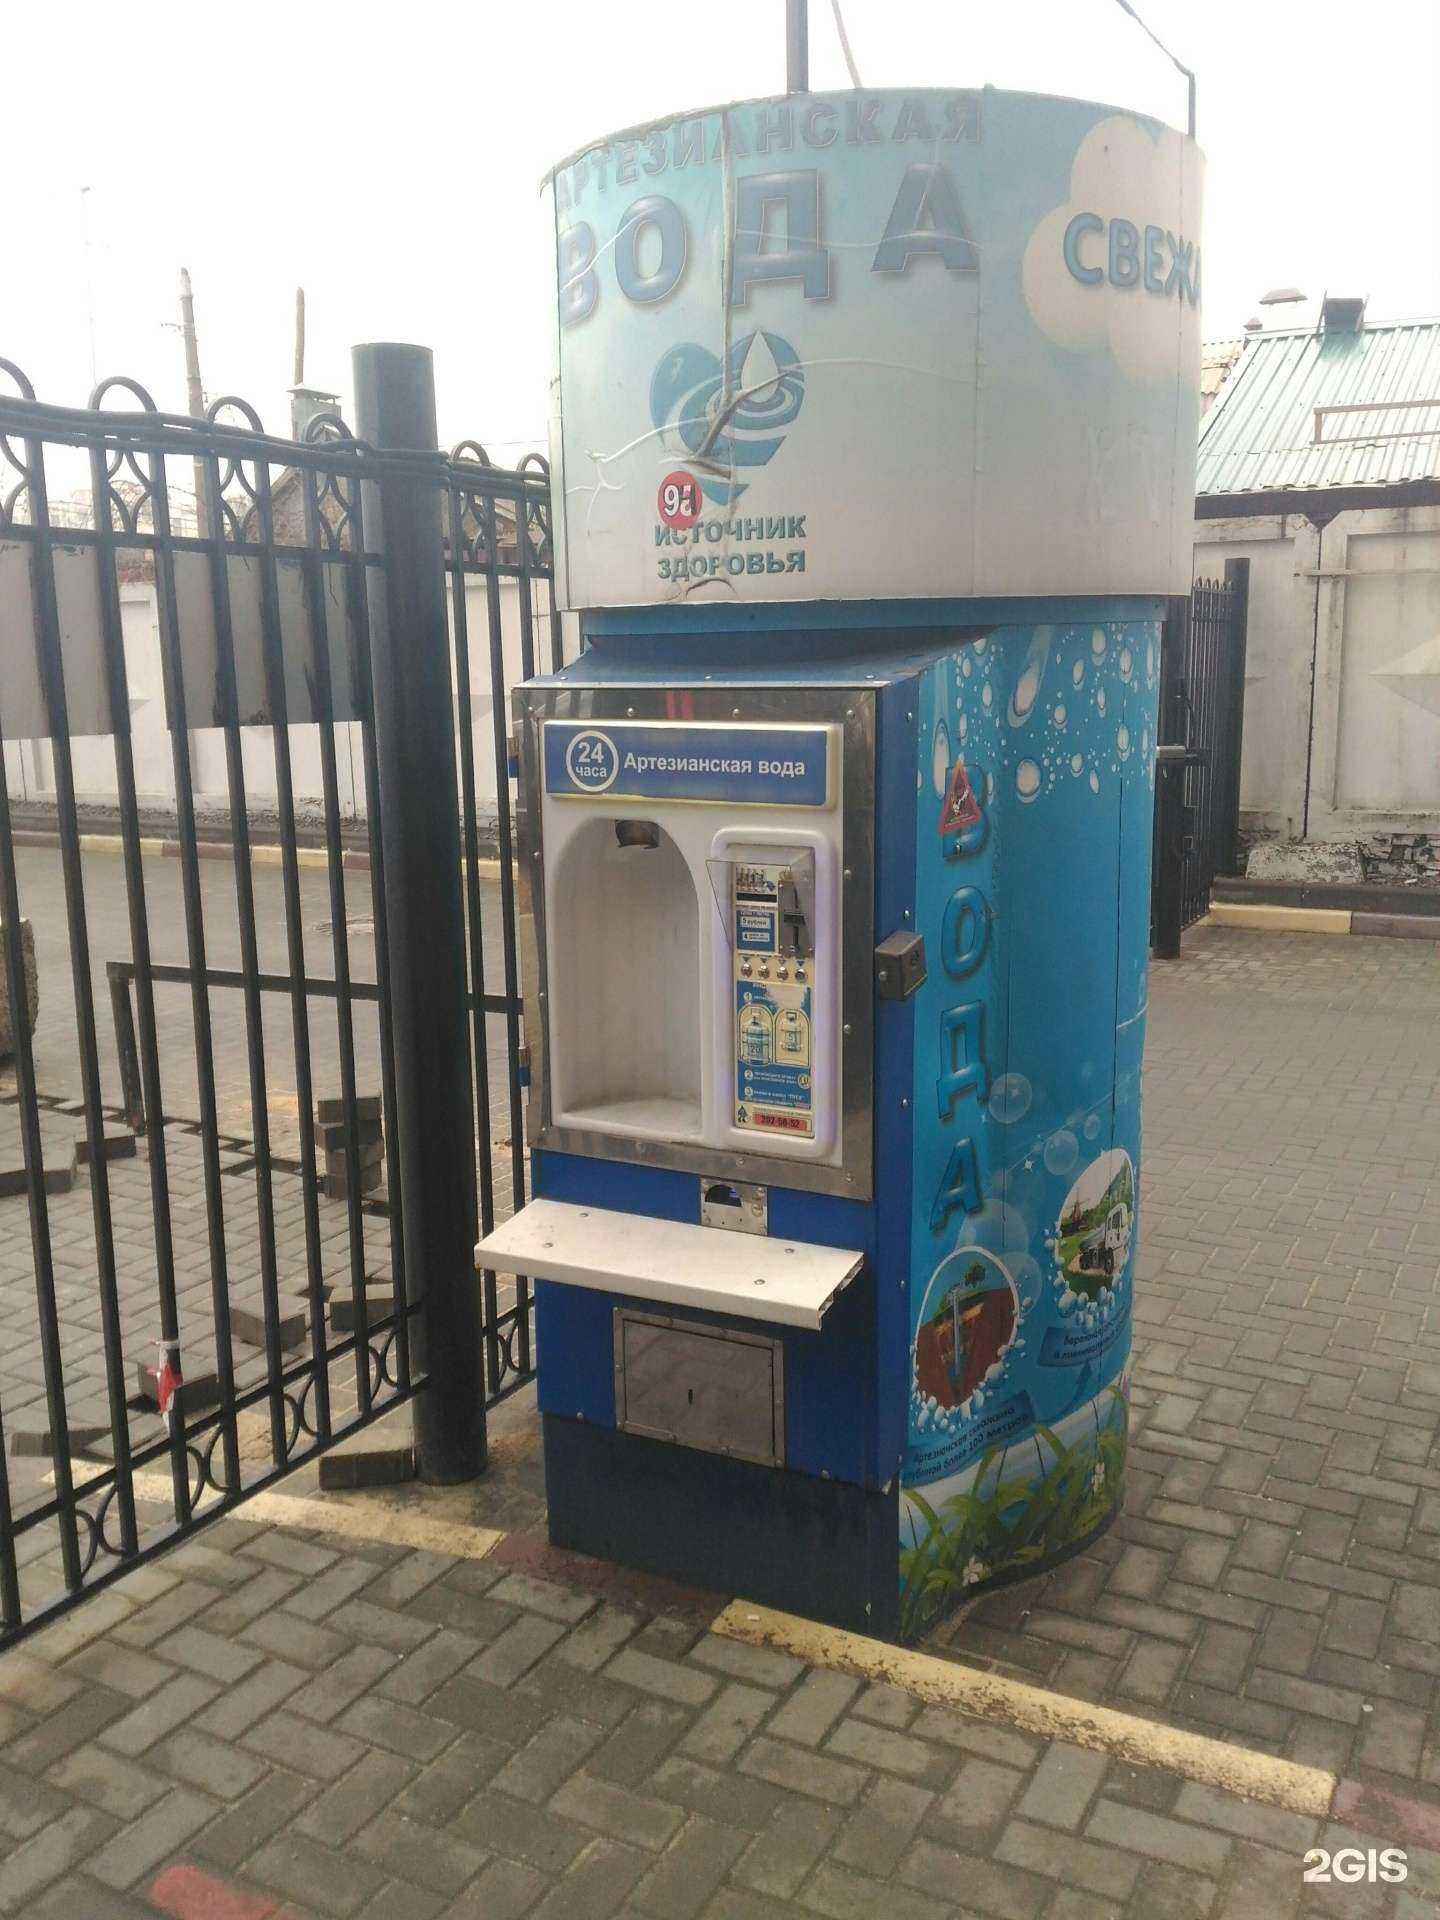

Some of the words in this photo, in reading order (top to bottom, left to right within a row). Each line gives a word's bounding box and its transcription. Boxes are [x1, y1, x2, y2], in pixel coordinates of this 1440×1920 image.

[558, 163, 980, 328] ВОДА
[578, 742, 605, 764] 24
[623, 752, 753, 774] Артезианская
[758, 759, 806, 778] вода
[575, 766, 607, 779] часа
